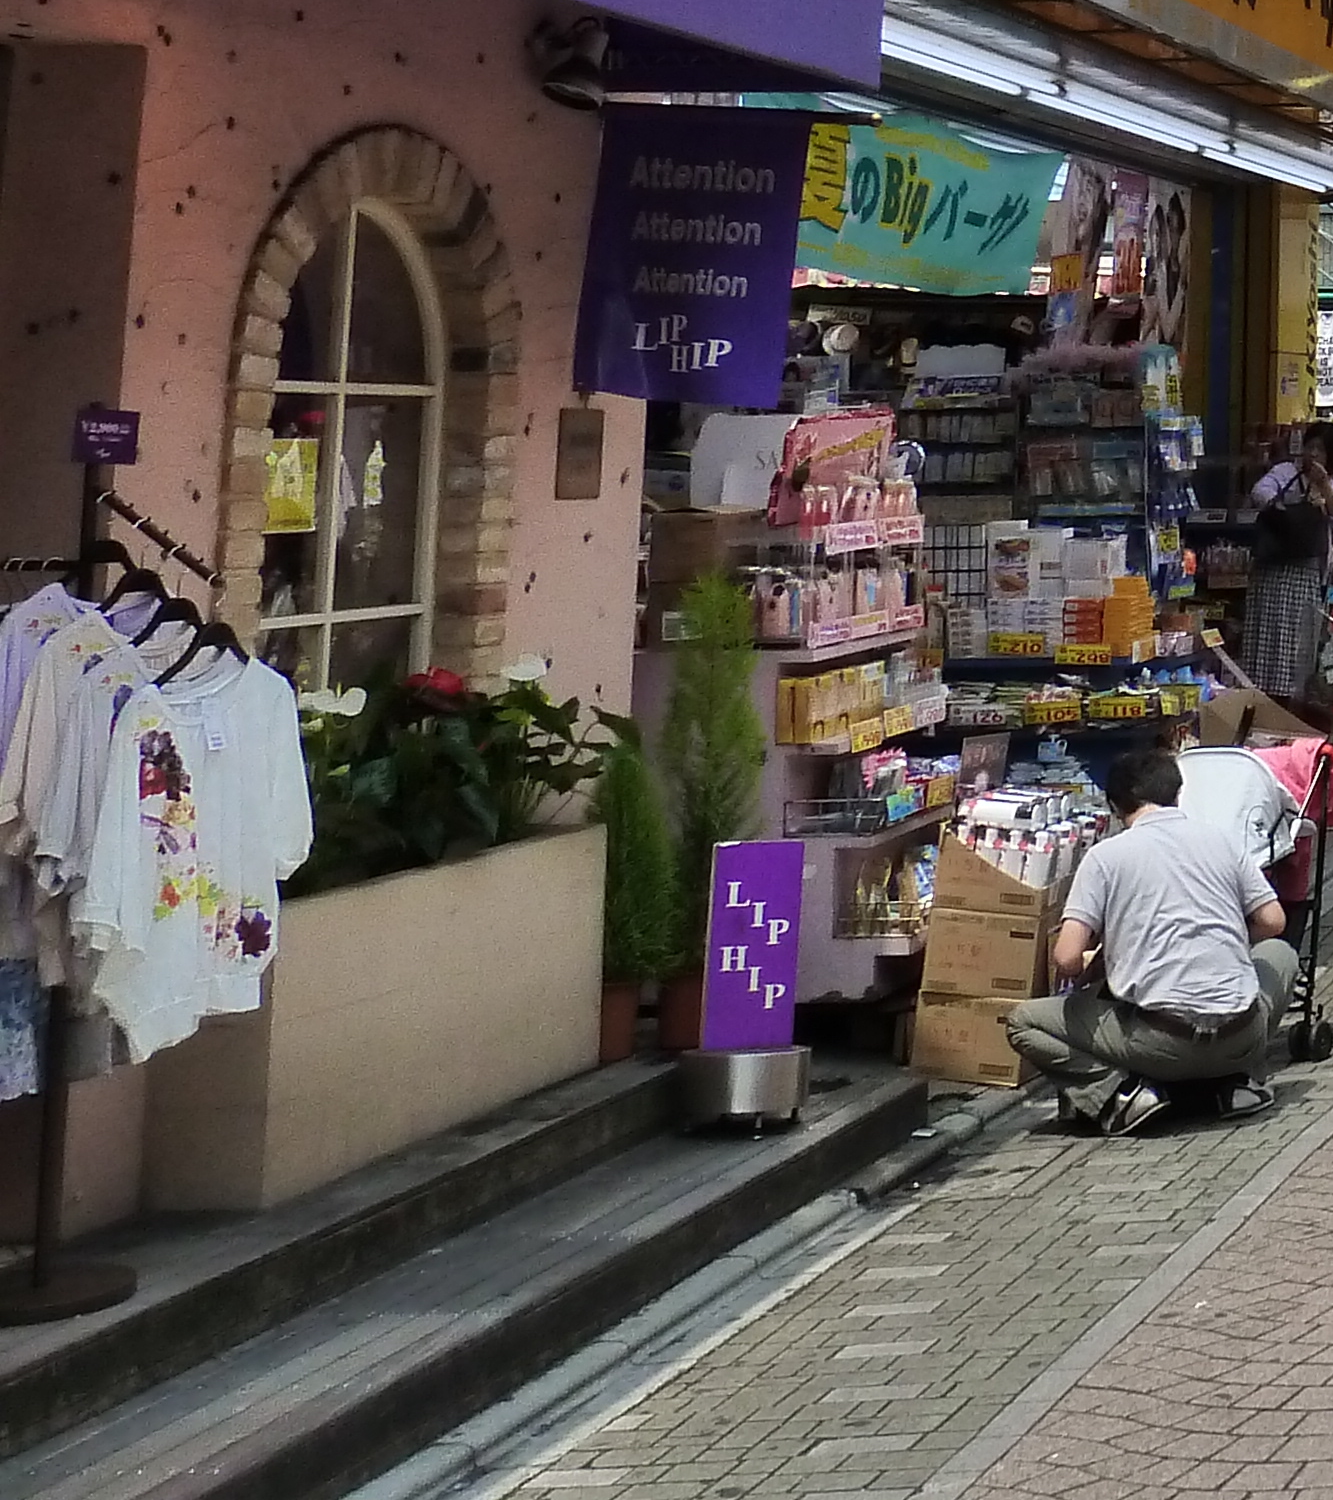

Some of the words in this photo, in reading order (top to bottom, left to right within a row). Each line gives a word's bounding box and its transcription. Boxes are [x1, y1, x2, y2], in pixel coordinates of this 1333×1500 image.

[630, 155, 776, 194] Attention
[632, 210, 762, 246] Attention
[633, 266, 749, 298] Attention
[631, 314, 688, 351] LIP
[669, 338, 734, 373] HIP
[725, 881, 790, 946] LIP
[719, 945, 786, 1010] HIP
